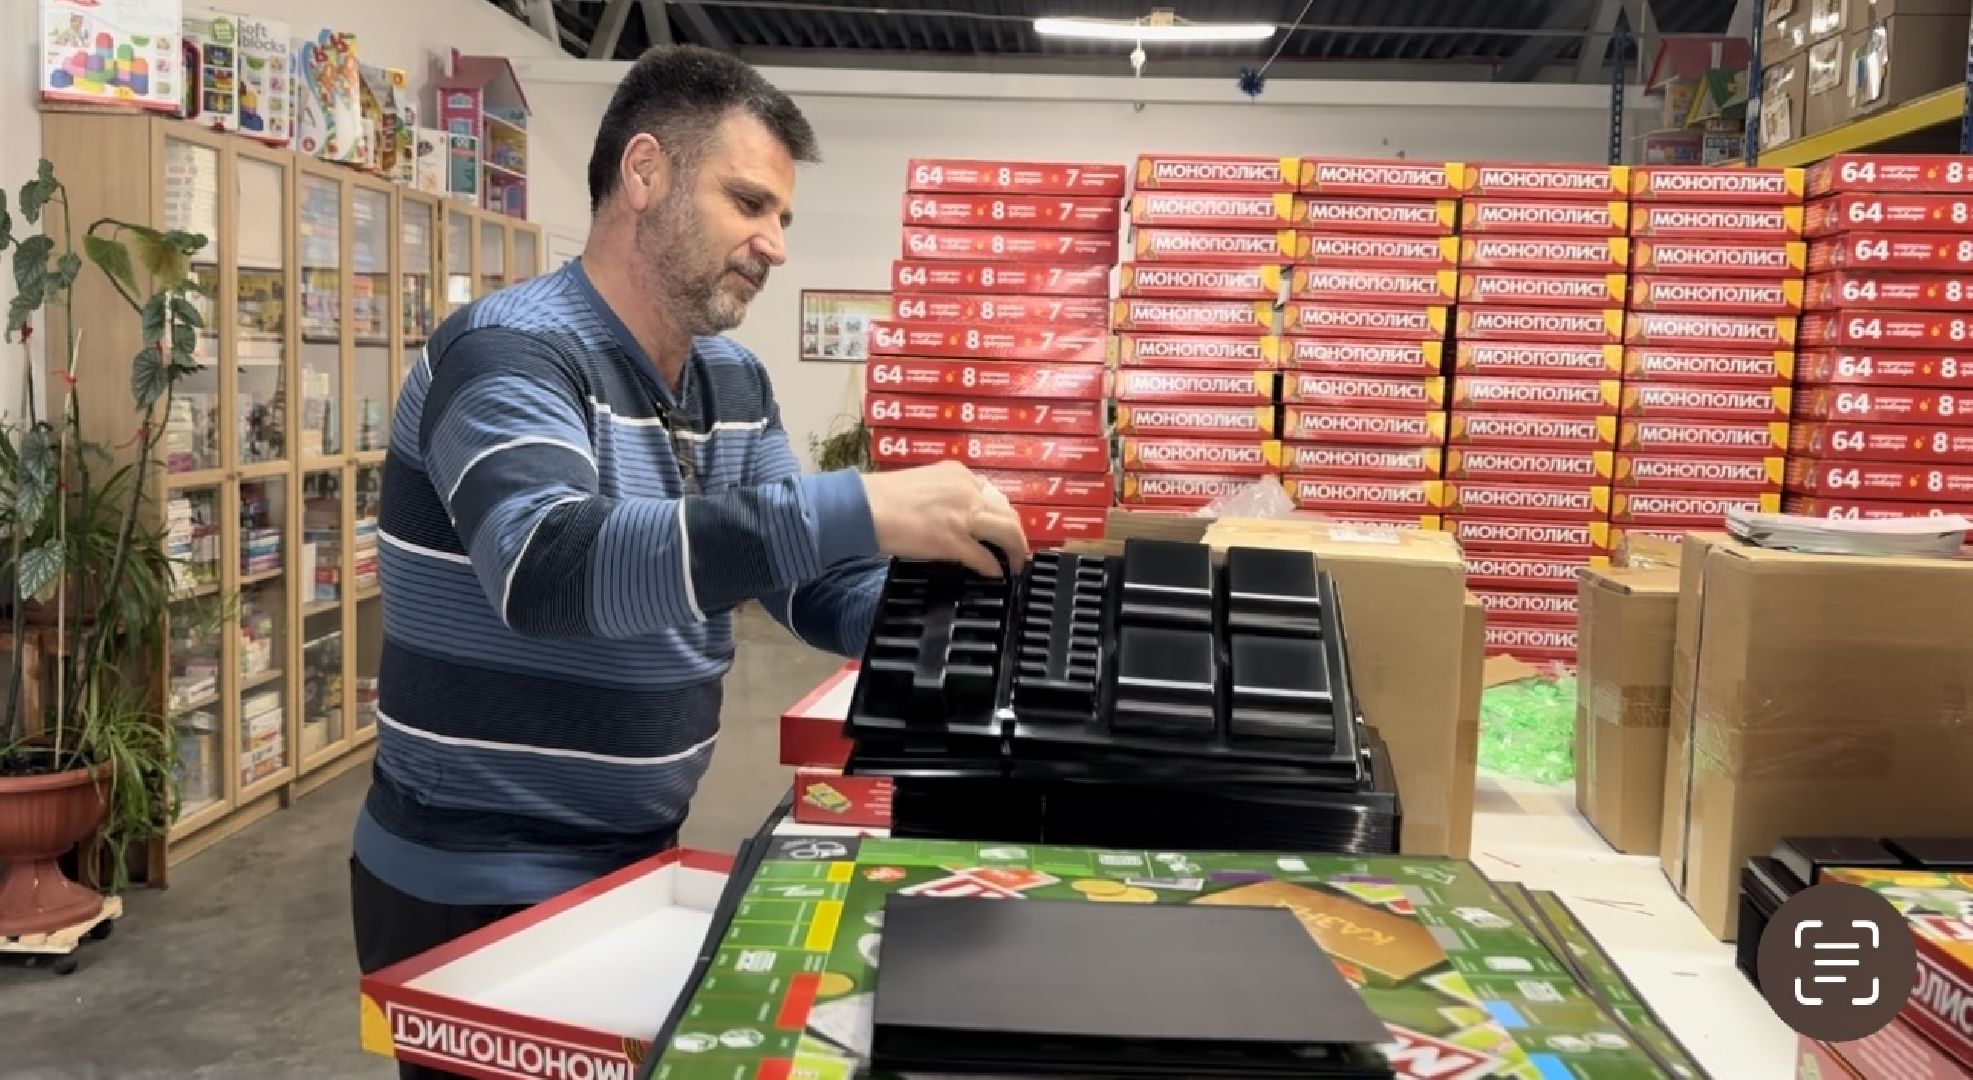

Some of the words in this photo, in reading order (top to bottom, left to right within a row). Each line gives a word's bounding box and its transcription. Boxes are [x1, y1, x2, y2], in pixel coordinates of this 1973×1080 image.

[915, 165, 943, 184] 64
[999, 168, 1010, 185] 8
[1066, 169, 1079, 186] 7
[1157, 164, 1280, 180] МОНОПОЛИСТ
[1320, 167, 1445, 185] МОНОПОЛИСТ
[1483, 171, 1609, 189] МОНОПОЛИСТ
[1841, 162, 1876, 183] 64
[1947, 162, 1963, 183] 8
[1654, 173, 1784, 191] МОНОПОЛИСТ
[910, 200, 937, 218] 64
[992, 200, 1004, 219] 8
[1059, 203, 1072, 220] 7
[1151, 199, 1272, 215] МОНОПОЛИСТ
[1312, 206, 1436, 221] МОНОПОЛИСТ
[1482, 208, 1608, 223] МОНОПОЛИСТ
[1849, 202, 1883, 223] 64
[1952, 202, 1968, 223] 8
[1653, 212, 1782, 228] МОНОПОЛИСТ
[910, 234, 937, 251] 64
[992, 235, 1004, 253] 8
[1059, 237, 1072, 254] 7
[1156, 236, 1277, 252] МОНОПОЛИСТ
[1316, 240, 1440, 256] МОНОПОЛИСТ
[1482, 243, 1608, 259] МОНОПОЛИСТ
[1855, 240, 1889, 261] 64
[1958, 240, 1973, 262] 8
[1657, 248, 1785, 265] МОНОПОЛИСТ
[900, 266, 927, 284] 64
[981, 268, 994, 285] 8
[1049, 269, 1062, 286] 7
[1138, 271, 1261, 287] МОНОПОЛИСТ
[1312, 276, 1437, 292] МОНОПОЛИСТ
[1481, 279, 1605, 296] МОНОПОЛИСТ
[1655, 285, 1782, 303] МОНОПОЛИСТ
[1843, 280, 1877, 300] 64
[1946, 280, 1962, 301] 8
[900, 301, 926, 318] 64
[981, 302, 994, 319] 8
[1049, 303, 1062, 320] 7
[1133, 306, 1254, 322] МОНОПОЛИСТ
[1304, 311, 1428, 328] МОНОПОЛИСТ
[1477, 315, 1603, 331] МОНОПОЛИСТ
[1647, 320, 1776, 338] МОНОПОЛИСТ
[1849, 318, 1882, 339] 64
[1951, 320, 1965, 340] 8
[876, 328, 905, 347] 64
[966, 330, 980, 348] 8
[1041, 333, 1055, 350] 7
[1139, 343, 1260, 358] МОНОПОЛИСТ
[1300, 346, 1423, 363] МОНОПОЛИСТ
[1477, 350, 1603, 367] МОНОПОЛИСТ
[1647, 357, 1773, 373] МОНОПОЛИСТ
[1838, 356, 1873, 377] 64
[1940, 358, 1957, 378] 8
[873, 365, 902, 383] 64
[963, 367, 975, 387] 8
[1036, 370, 1050, 389] 7
[1132, 377, 1254, 392] МОНОПОЛИСТ
[1303, 381, 1425, 397] МОНОПОЛИСТ
[1474, 385, 1600, 401] МОНОПОЛИСТ
[1644, 392, 1771, 408] МОНОПОЛИСТ
[1836, 393, 1870, 414] 64
[1938, 394, 1954, 416] 8
[872, 401, 901, 420] 64
[962, 402, 974, 422] 8
[1035, 405, 1049, 423] 7
[1135, 412, 1255, 427] МОНОПОЛИСТ
[1304, 417, 1426, 433] МОНОПОЛИСТ
[1470, 421, 1596, 438] МОНОПОЛИСТ
[1643, 427, 1769, 444] МОНОПОЛИСТ
[1832, 430, 1865, 451] 64
[1932, 432, 1948, 453] 8
[879, 437, 908, 456] 64
[968, 439, 981, 457] 8
[1041, 442, 1055, 460] 7
[1141, 446, 1261, 461] МОНОПОЛИСТ
[1300, 451, 1423, 467] МОНОПОЛИСТ
[1467, 456, 1593, 472] МОНОПОЛИСТ
[1637, 463, 1763, 480] МОНОПОЛИСТ
[1827, 468, 1860, 489] 64
[1927, 471, 1943, 491] 8
[1048, 477, 1062, 495] 7
[1143, 480, 1242, 495] МОНОПОЛИ
[1302, 486, 1425, 503] МОНОПОЛИСТ
[1463, 491, 1590, 508] МОНОПОЛИСТ
[1046, 512, 1060, 530] 7
[1462, 526, 1588, 543] МОНОПОЛИСТ
[1465, 561, 1580, 578] МОНОПОЛИС
[1481, 595, 1578, 611] ОНОПОЛИС
[1485, 630, 1577, 647] НОПОЛИС
[394, 1013, 627, 1080] МОНОПОЛИСТ
